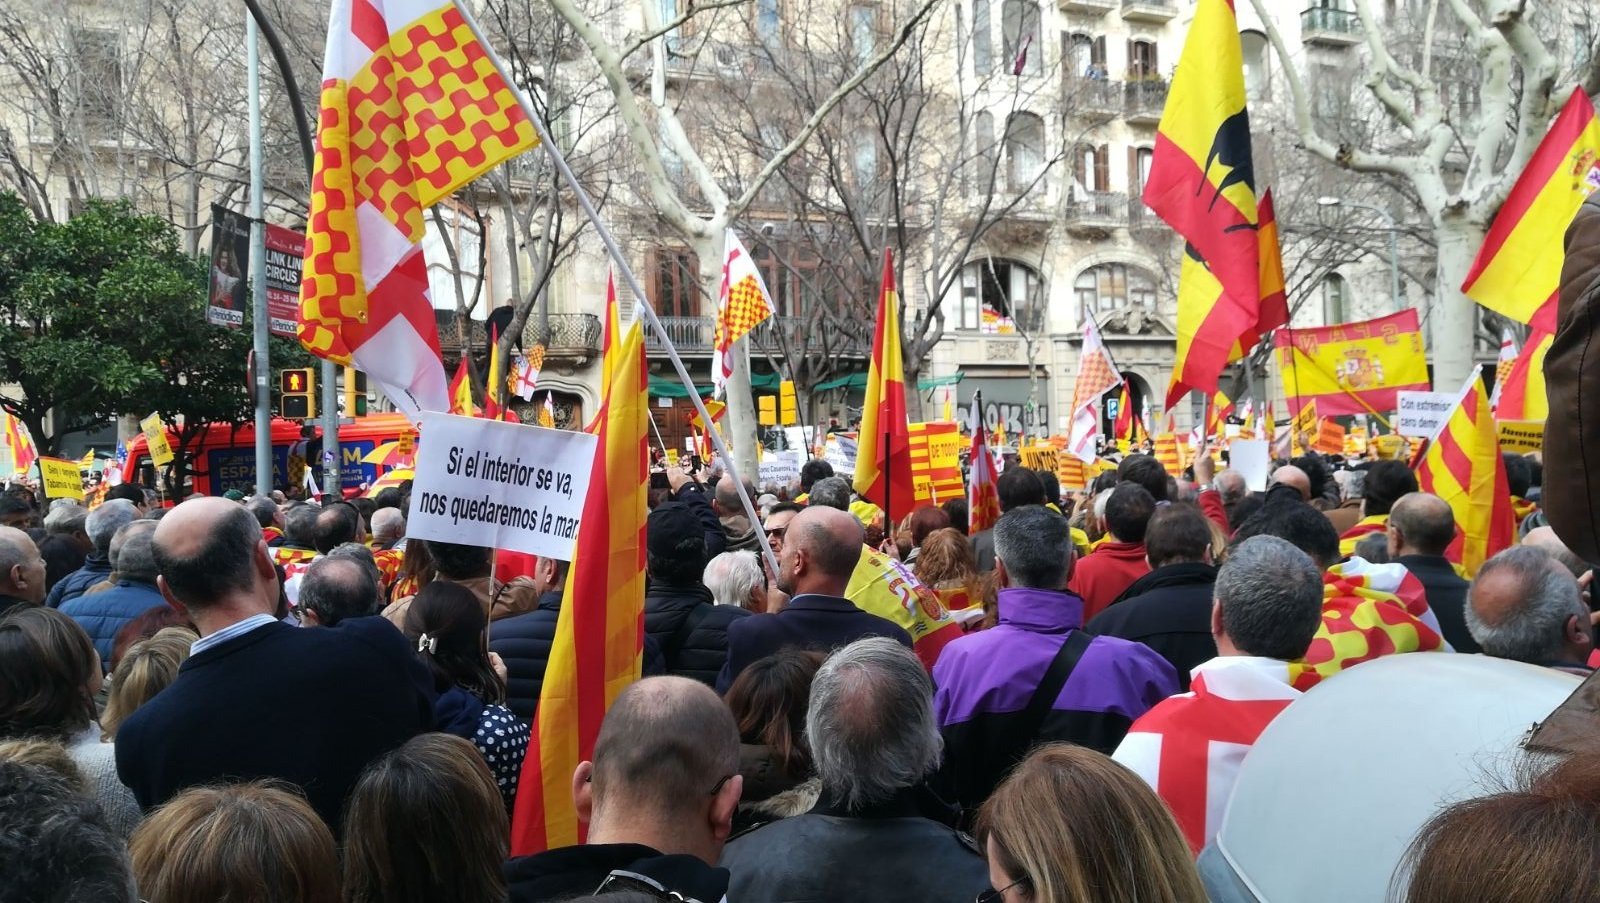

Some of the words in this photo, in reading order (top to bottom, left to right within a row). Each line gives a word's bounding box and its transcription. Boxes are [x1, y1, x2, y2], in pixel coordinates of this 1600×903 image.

[266, 250, 288, 266] LINK
[288, 257, 303, 271] LIN
[266, 265, 298, 283] CIRCUS
[1502, 426, 1544, 438] Juntos
[931, 444, 940, 458] DE
[1026, 450, 1058, 471] JUNTOS
[447, 446, 464, 475] Si
[465, 450, 480, 478] el
[482, 452, 535, 487] interior
[535, 467, 553, 491] se
[556, 470, 573, 501] va,
[419, 491, 447, 516] nos
[450, 495, 538, 533] quedaremos
[539, 505, 552, 535] la
